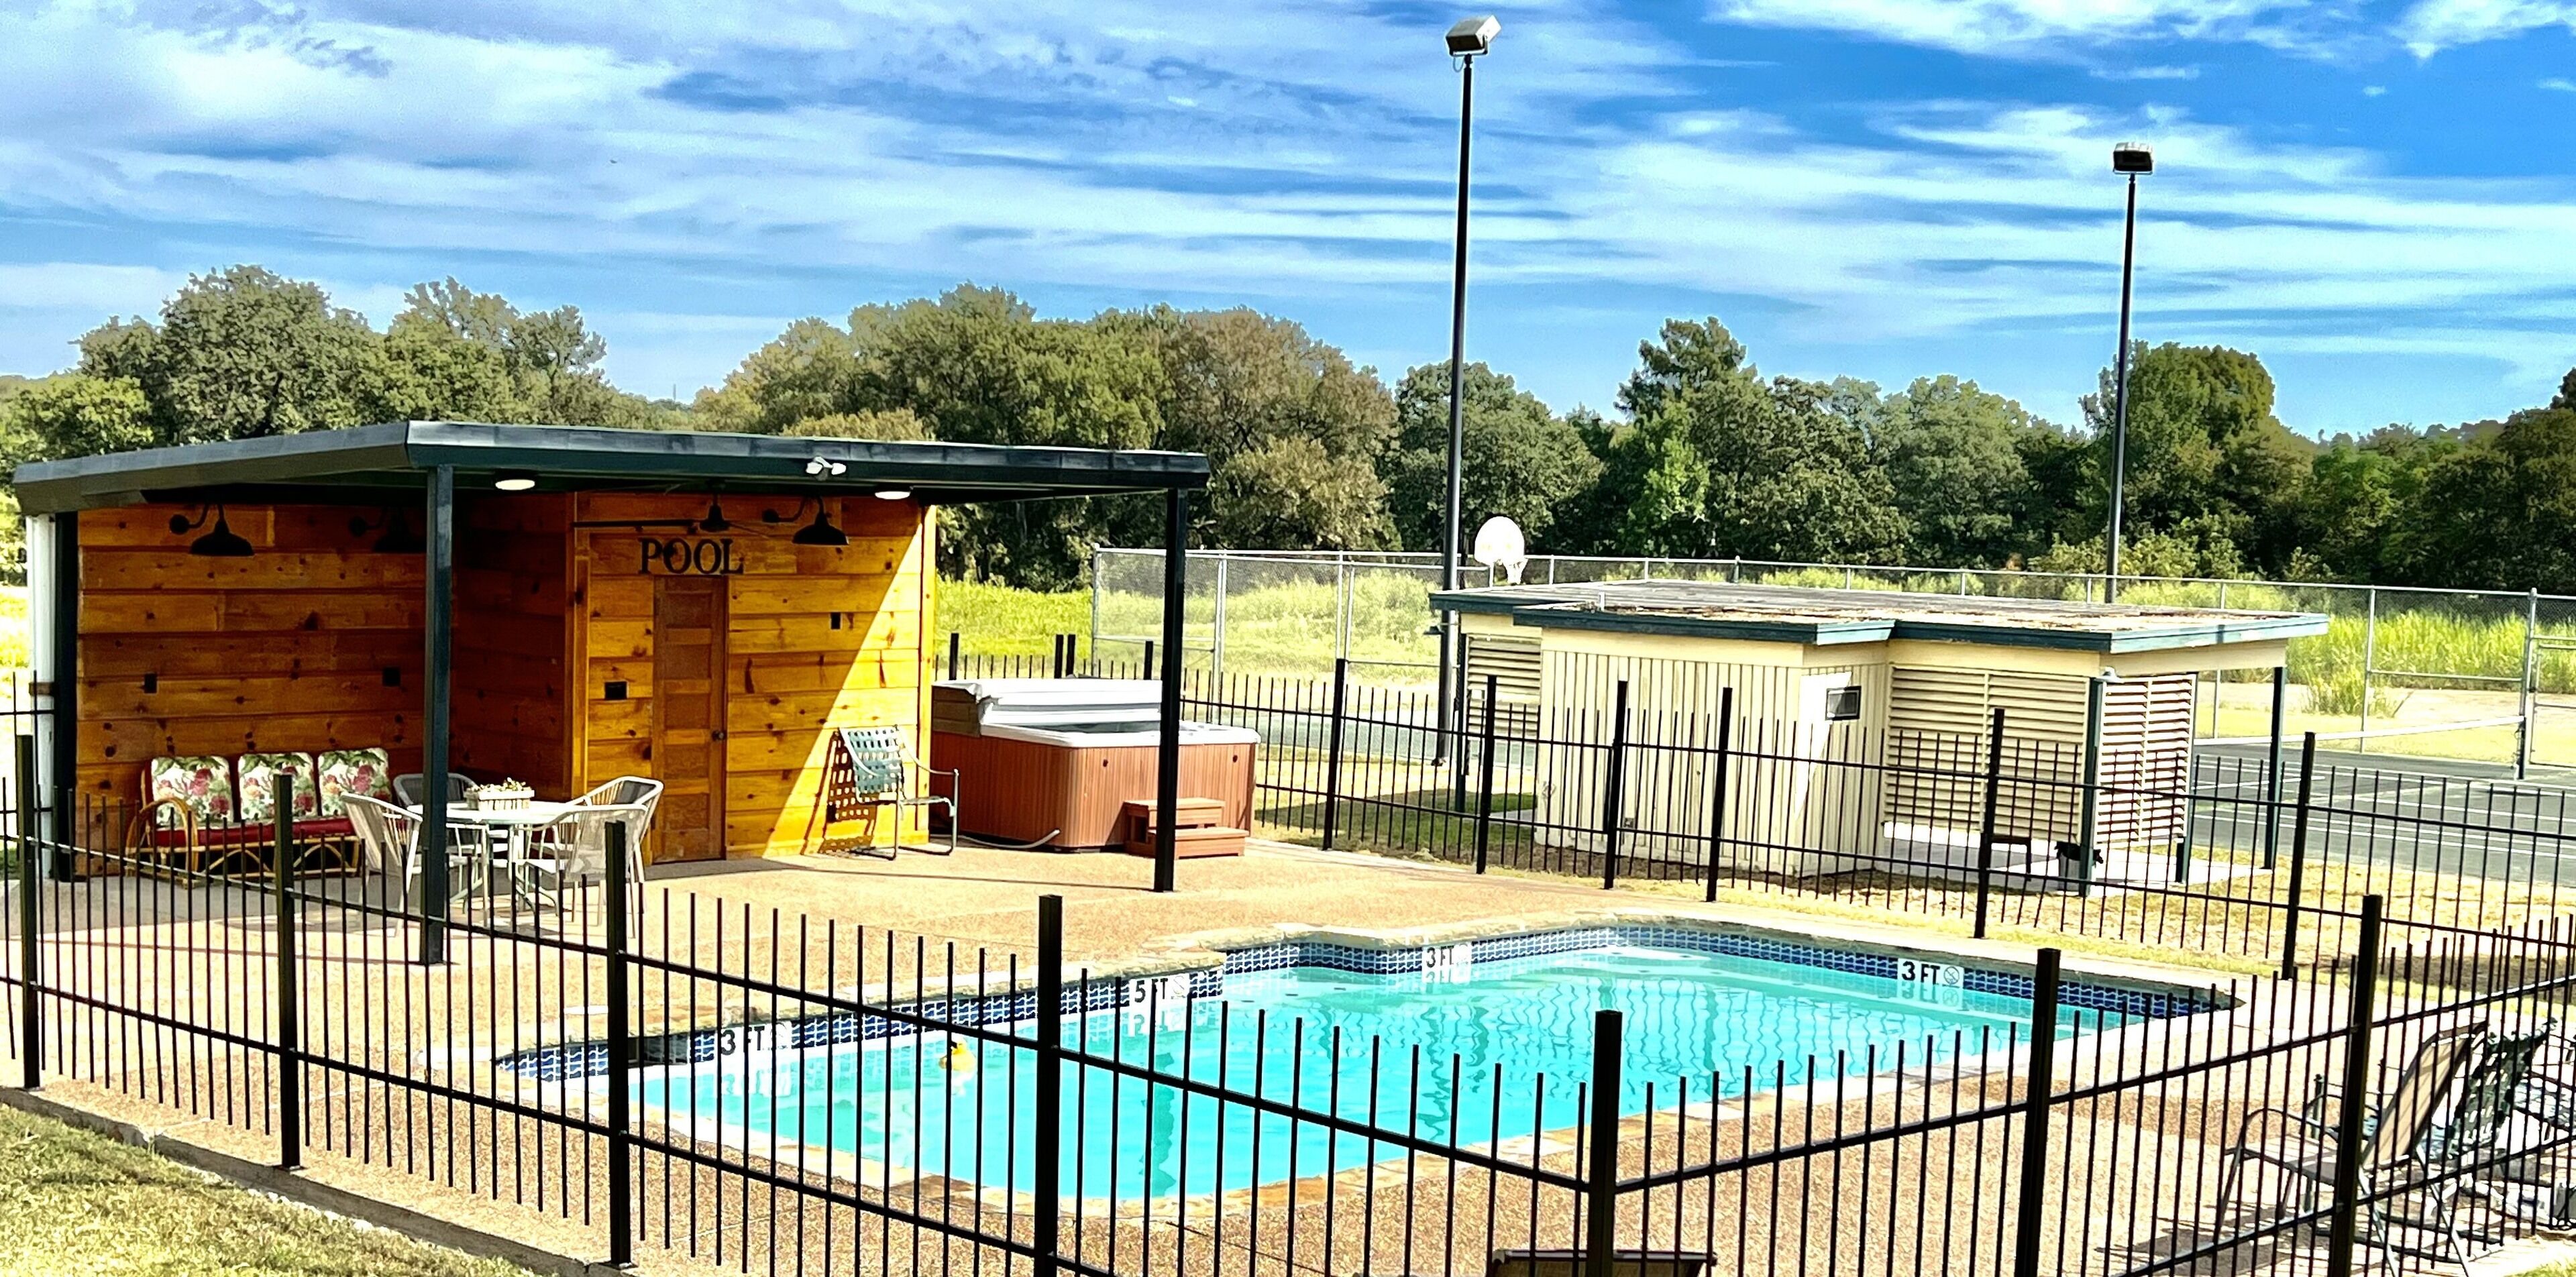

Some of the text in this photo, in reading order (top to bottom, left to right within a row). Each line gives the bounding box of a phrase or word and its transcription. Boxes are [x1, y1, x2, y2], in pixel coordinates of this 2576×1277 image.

[638, 537, 744, 575] POOL
[1426, 946, 1436, 967] 3
[1901, 960, 1941, 985] 3 FT
[1134, 979, 1146, 1003] 5
[720, 1029, 737, 1056] 3
